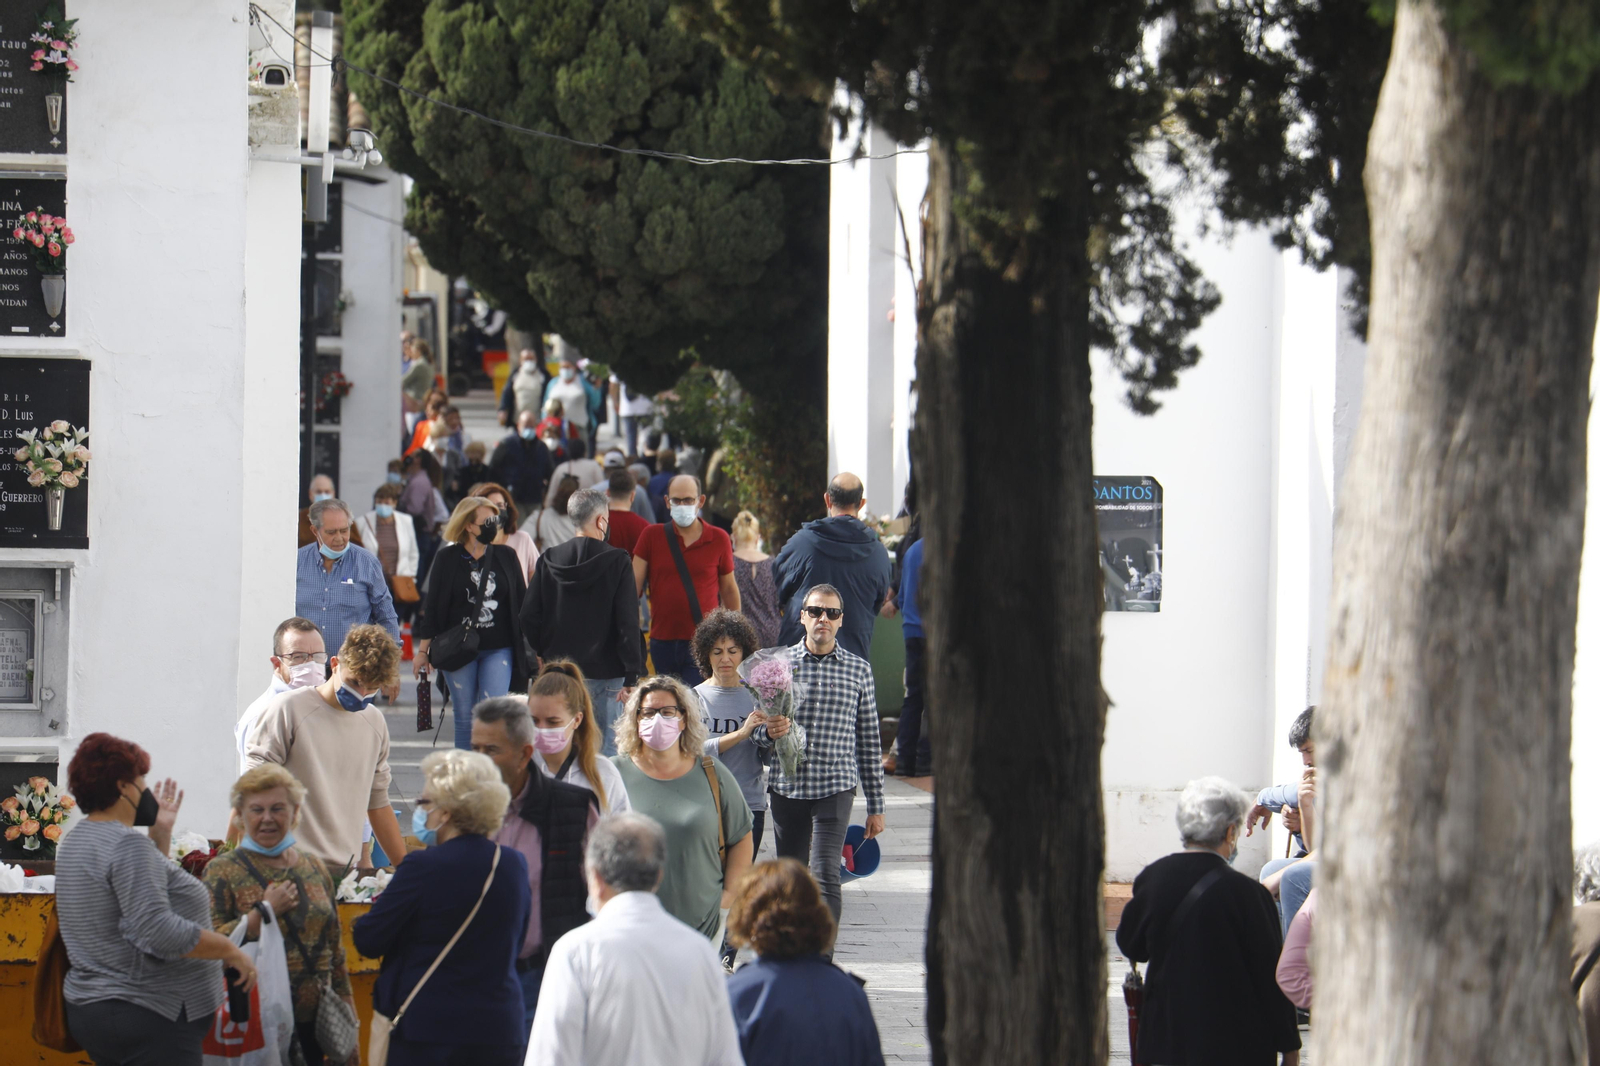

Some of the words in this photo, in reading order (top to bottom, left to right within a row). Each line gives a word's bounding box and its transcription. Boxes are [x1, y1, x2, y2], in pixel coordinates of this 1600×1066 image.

[0, 201, 23, 211] INA
[6, 219, 38, 230] FRA
[3, 250, 28, 260] AÑOS
